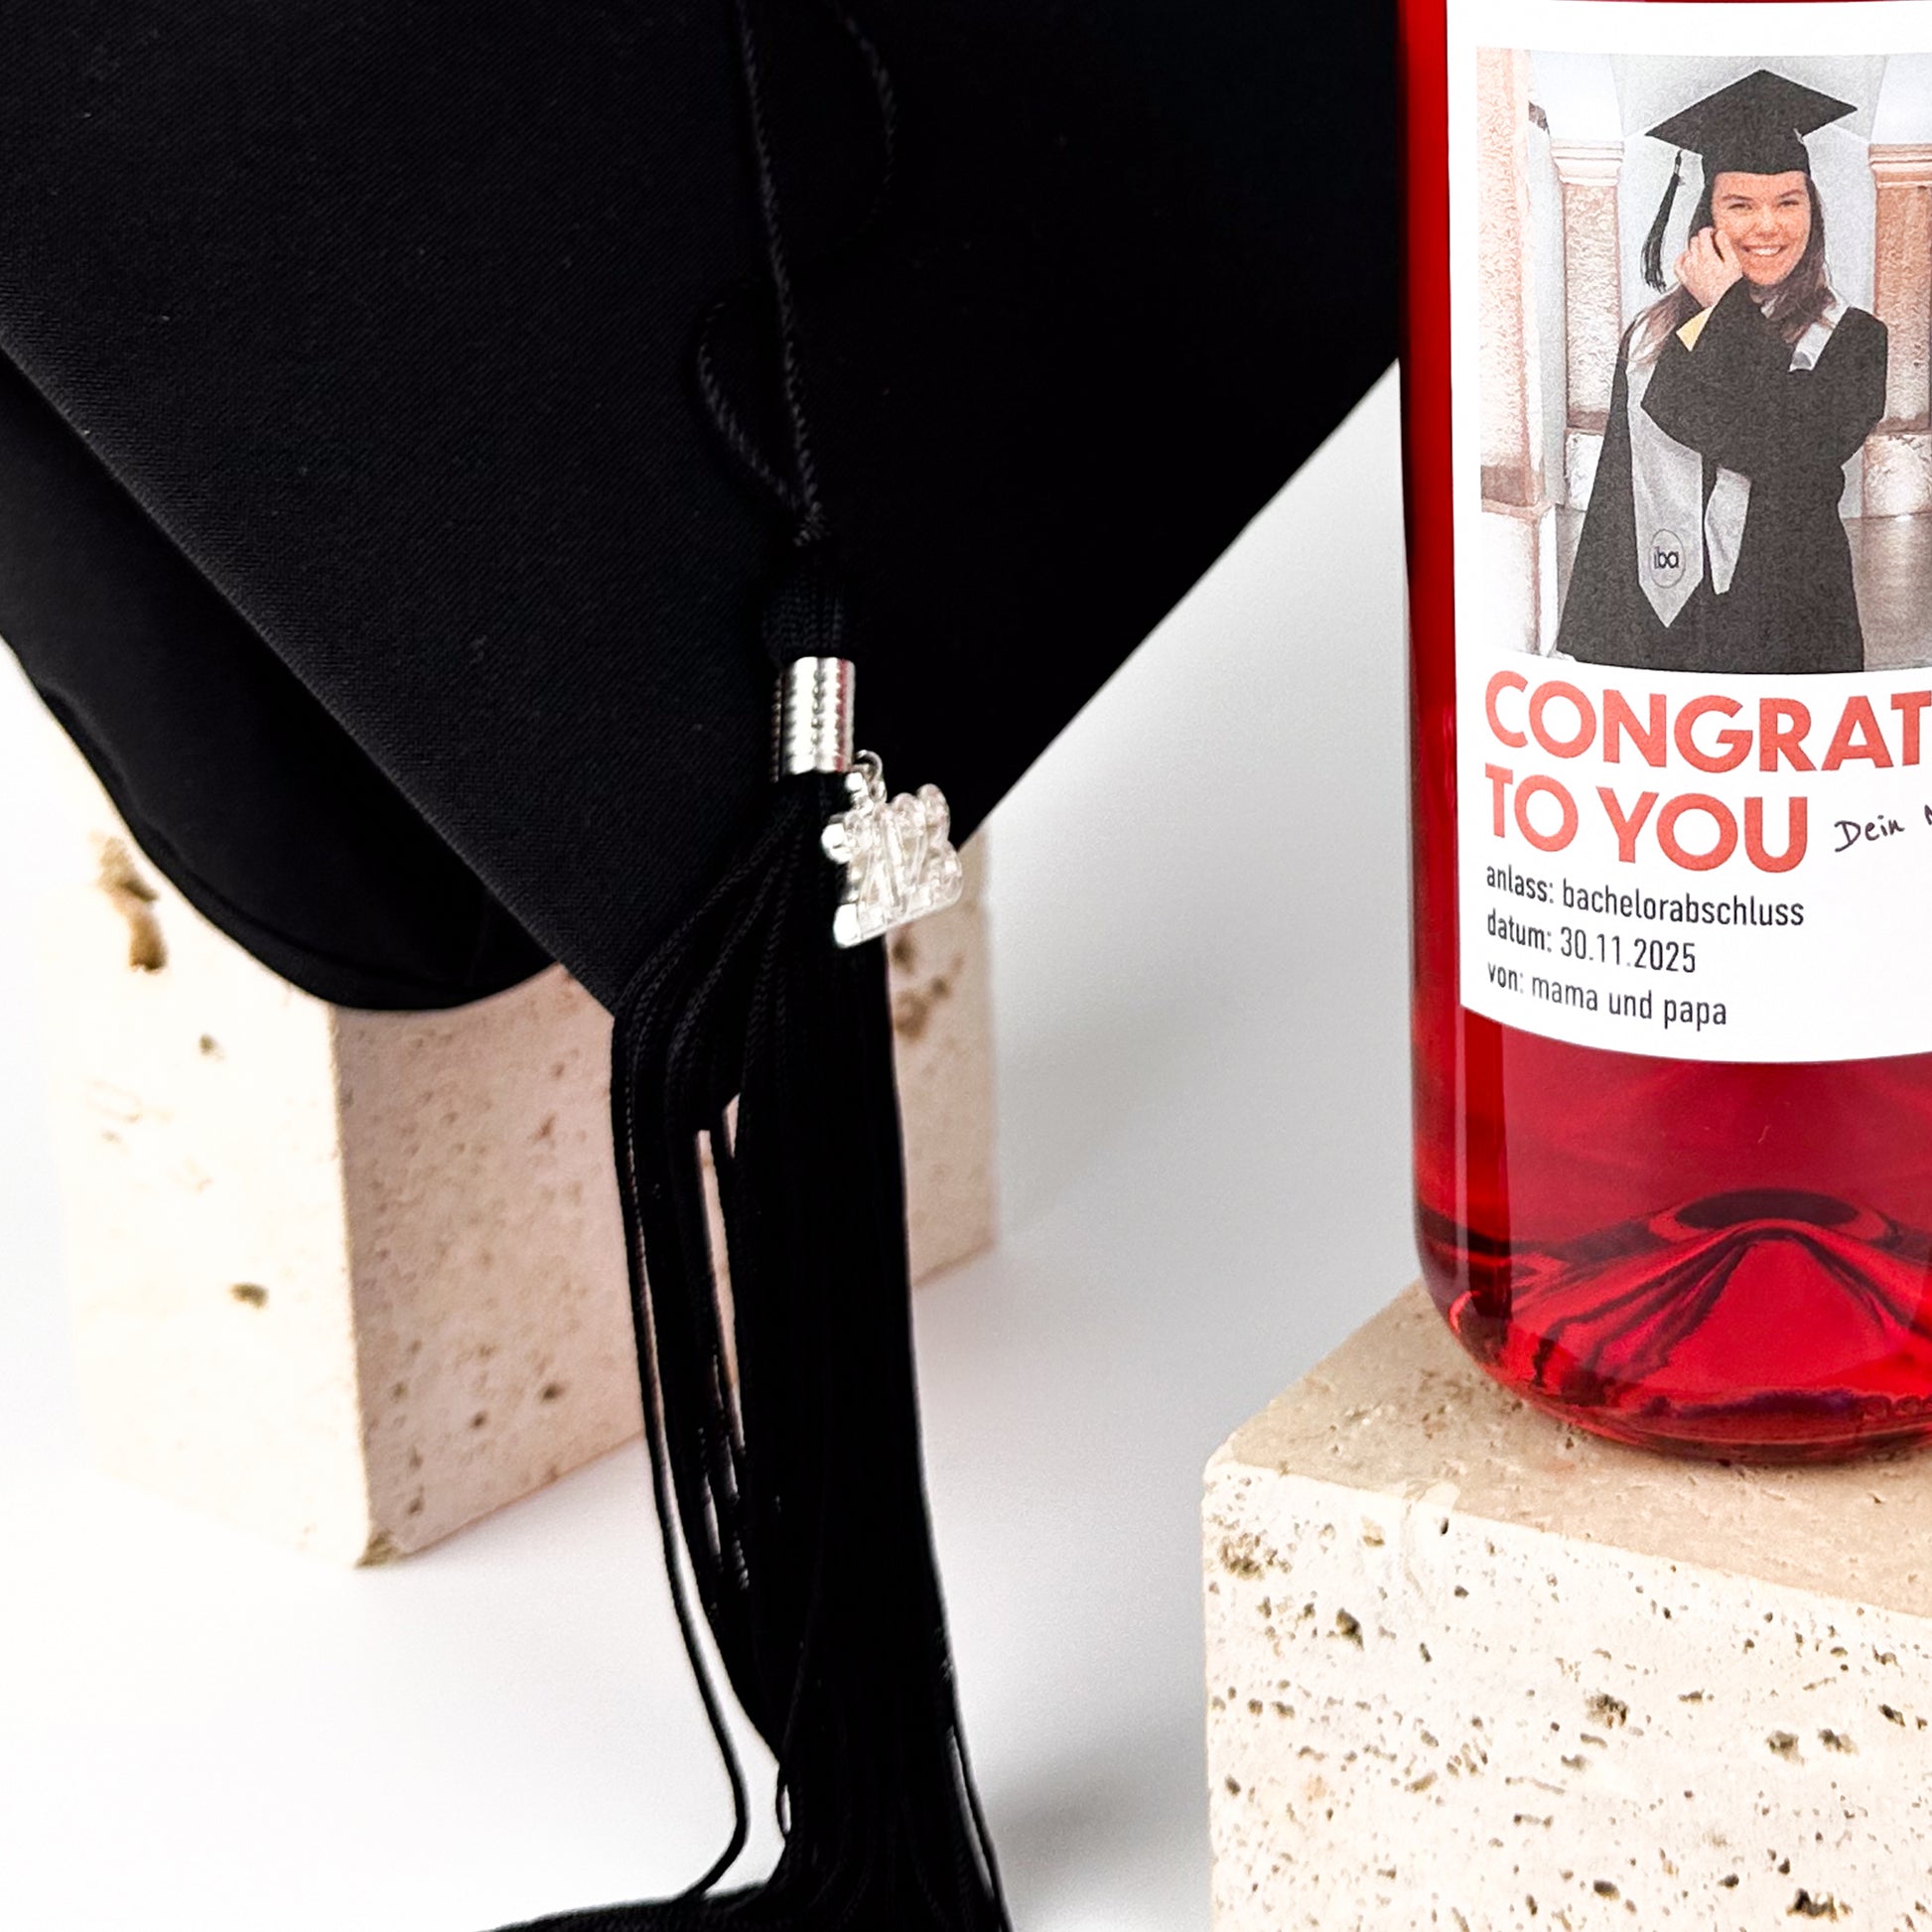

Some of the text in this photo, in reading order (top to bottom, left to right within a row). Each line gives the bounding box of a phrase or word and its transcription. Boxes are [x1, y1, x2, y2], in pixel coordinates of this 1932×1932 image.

[1485, 670, 1932, 773] CONGRAT
[1485, 762, 1807, 873] TO YOU
[1835, 814, 1905, 853] Dein
[1486, 864, 1804, 926] anlass: bachelorabschluss
[1486, 908, 1696, 973] datum: 30.11.2025
[1487, 960, 1726, 1032] von: mama und papa
